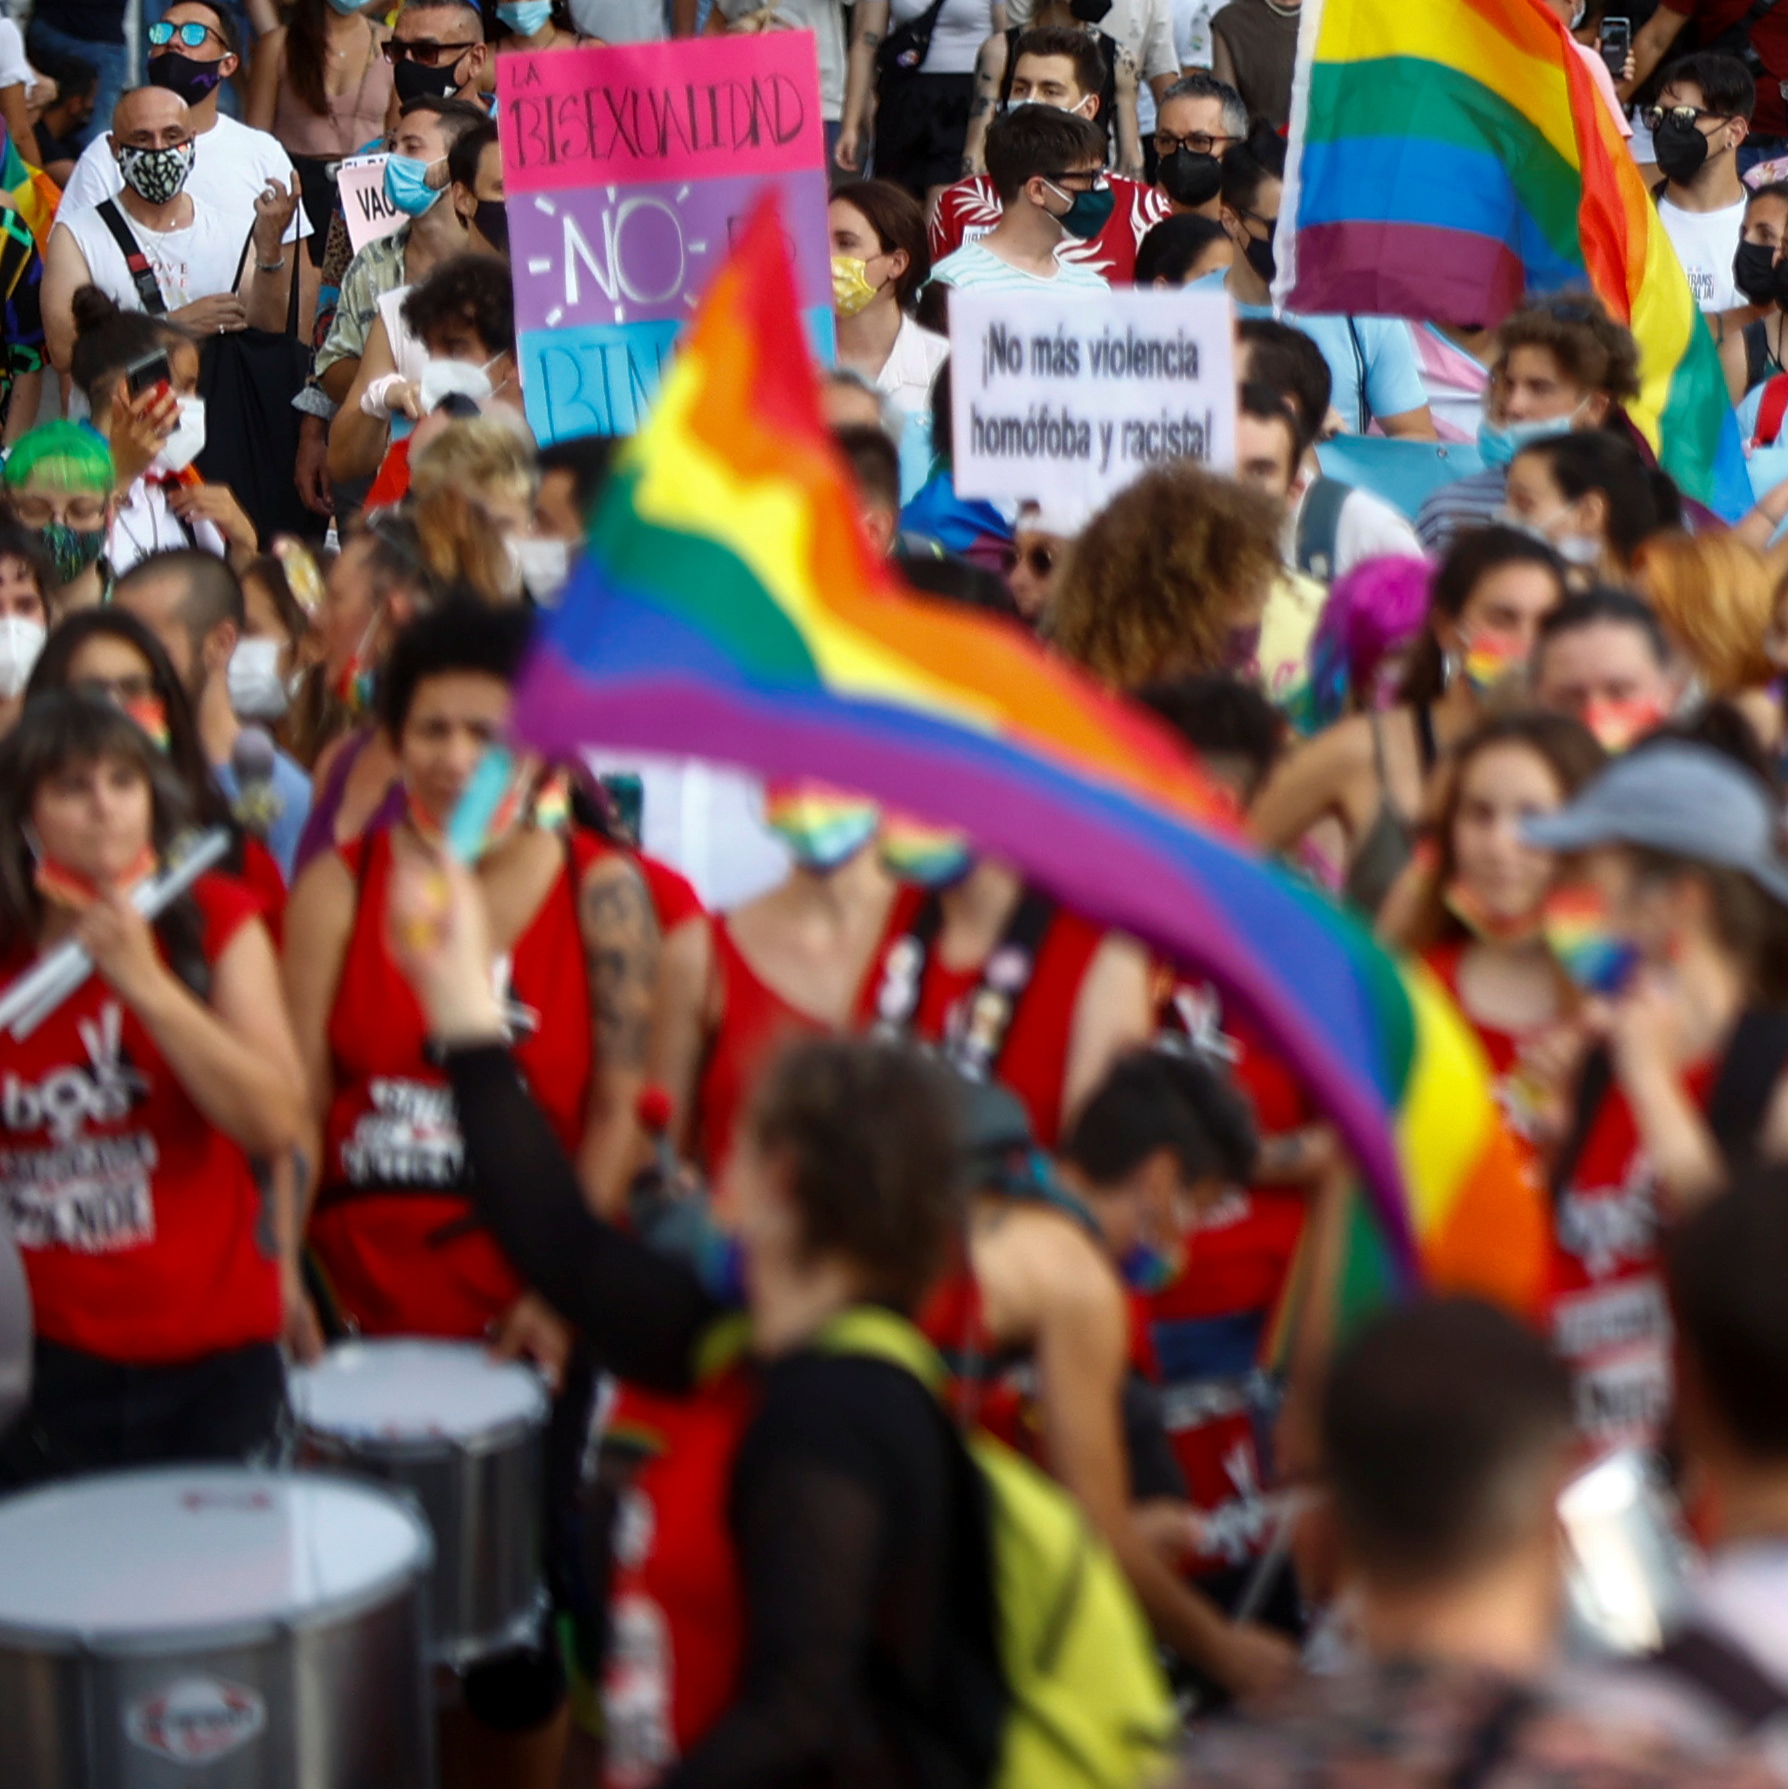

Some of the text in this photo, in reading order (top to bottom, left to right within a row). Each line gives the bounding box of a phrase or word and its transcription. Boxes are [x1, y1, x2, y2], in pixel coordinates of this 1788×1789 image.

[511, 61, 542, 89] LA
[508, 74, 805, 168] BISEXUALIDAD
[356, 188, 397, 222] VAC
[151, 261, 189, 275] OVE
[562, 196, 685, 306] NO
[981, 320, 1200, 390] ¡No más violencia
[969, 401, 1213, 475] homófoba y racista!
